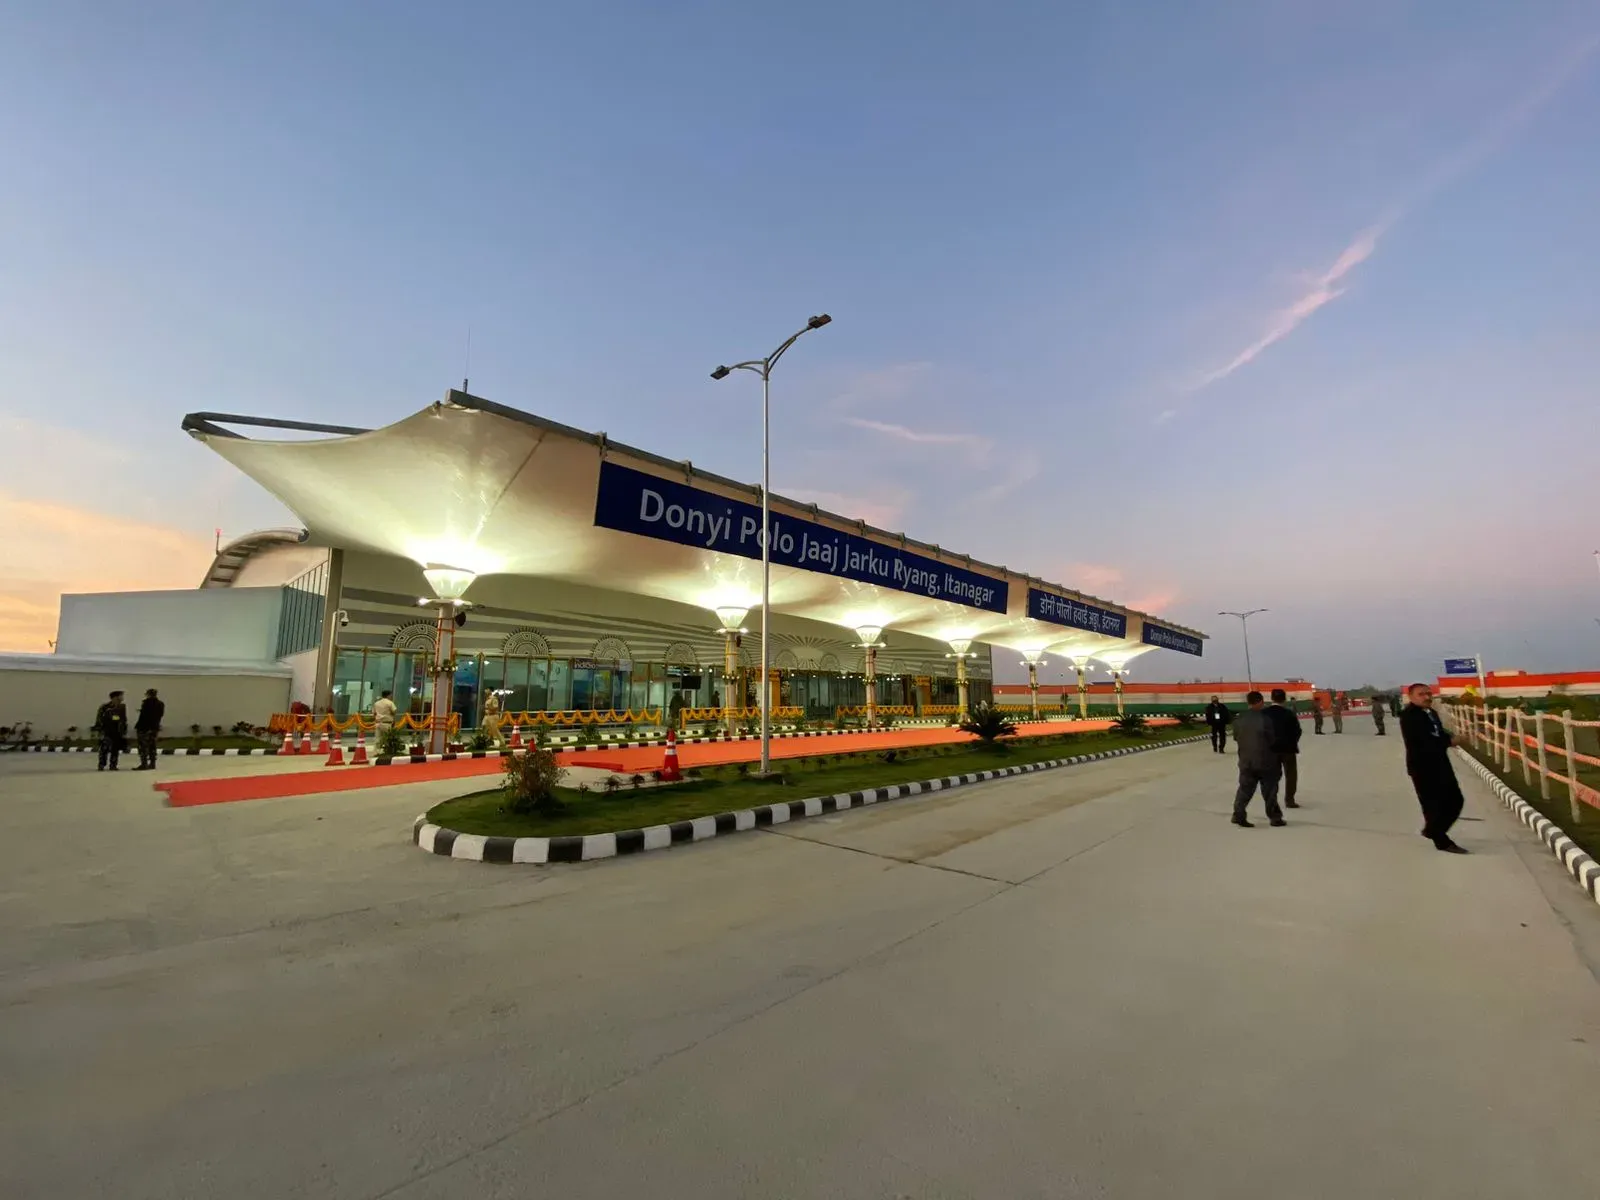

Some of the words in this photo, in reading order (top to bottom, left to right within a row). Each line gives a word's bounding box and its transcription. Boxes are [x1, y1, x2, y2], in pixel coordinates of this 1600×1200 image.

[639, 487, 732, 547] Donyi
[740, 515, 794, 554] Polo
[798, 532, 839, 572] Jaaj
[842, 543, 888, 576] Jarku
[893, 557, 940, 596] Ryang,
[944, 572, 994, 607] Itanagar
[1040, 594, 1055, 616] डोनी
[1056, 598, 1072, 620] पोलो
[1073, 606, 1088, 625] हवाई
